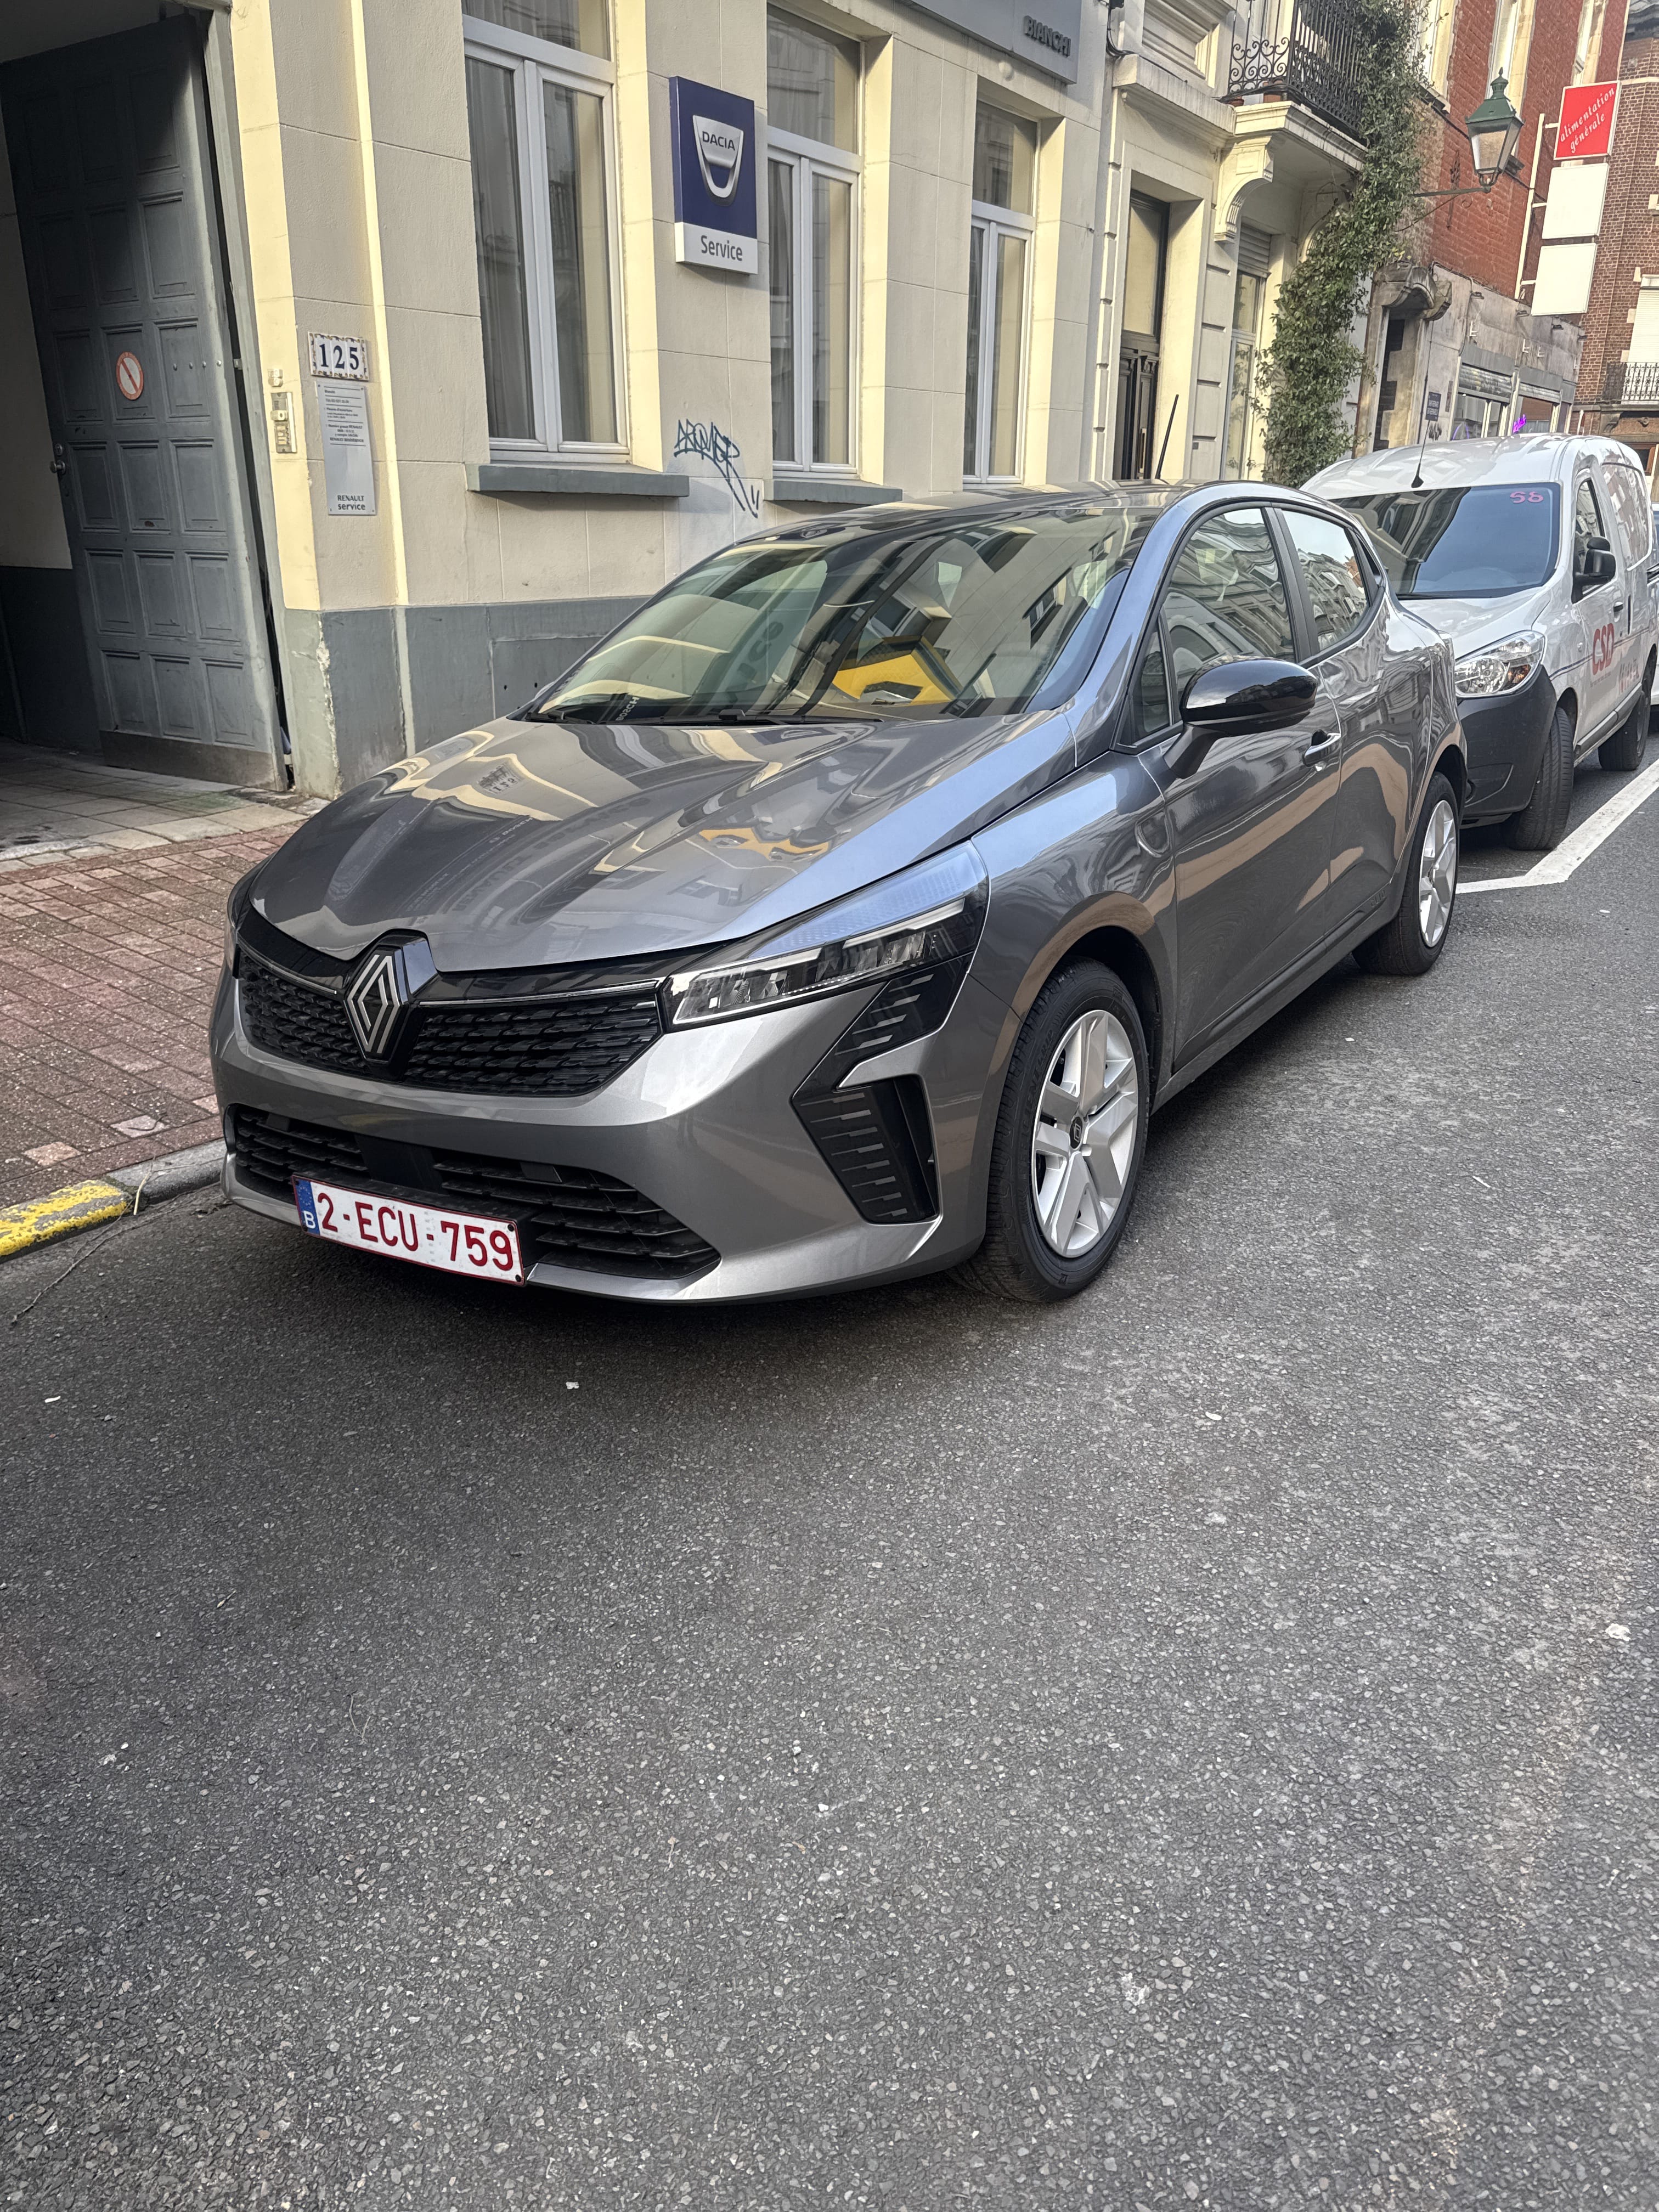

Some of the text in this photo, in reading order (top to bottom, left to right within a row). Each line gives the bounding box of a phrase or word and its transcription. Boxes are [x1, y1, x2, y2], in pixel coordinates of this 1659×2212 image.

[1023, 15, 1071, 58] BIANCHI
[1560, 88, 1615, 142] alimentation
[702, 131, 735, 151] DACIA
[1570, 113, 1605, 154] générale
[701, 235, 742, 261] Service
[319, 343, 359, 370] 125
[303, 1210, 316, 1229] B
[318, 1192, 514, 1271] 2-ECU-759
